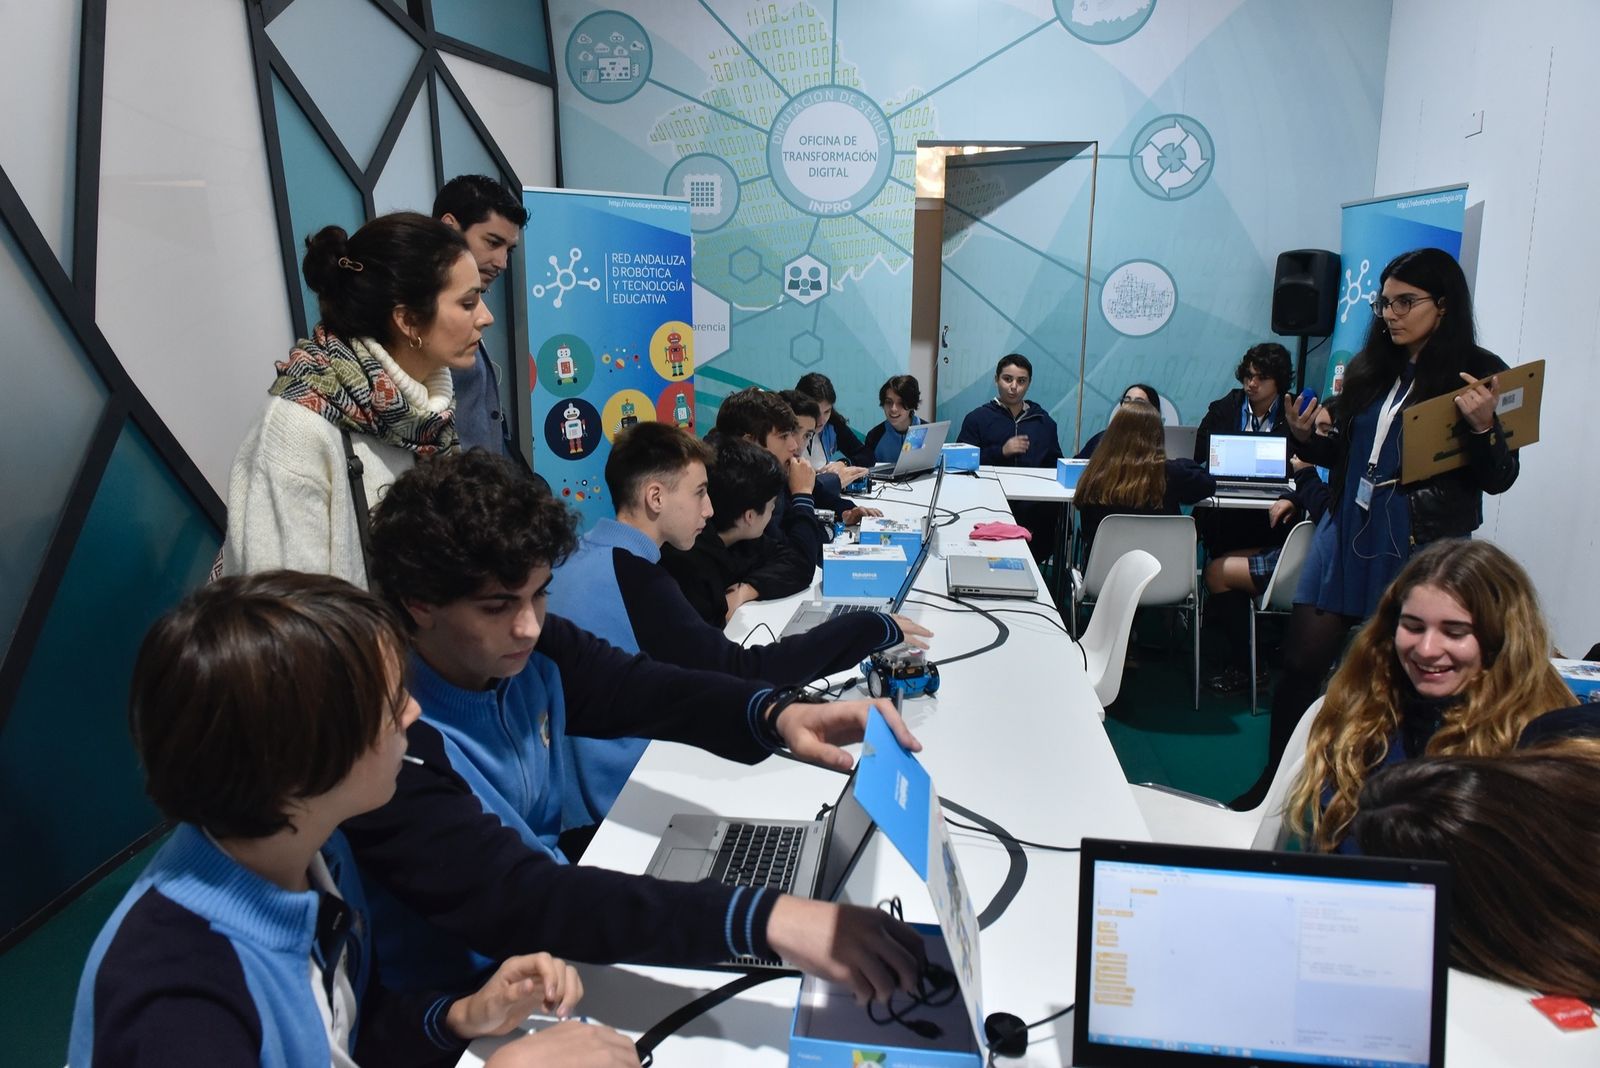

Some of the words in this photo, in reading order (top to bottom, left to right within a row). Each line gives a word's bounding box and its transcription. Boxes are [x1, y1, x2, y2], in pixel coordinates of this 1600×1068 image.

[840, 91, 856, 104] DE
[859, 101, 889, 146] SEVILLA
[799, 135, 841, 146] OFICINA
[844, 135, 857, 146] DE
[783, 149, 878, 162] TRANSFORMACIÓN
[808, 167, 849, 178] DIGITAL
[808, 199, 852, 214] INPRO
[611, 252, 631, 264] RED
[633, 253, 687, 266] ANDALUZA
[620, 265, 672, 278] ROBÓTICA
[612, 280, 620, 290] Y
[622, 279, 686, 292] TECNOLOGÍA
[613, 293, 668, 305] EDUCATIVA
